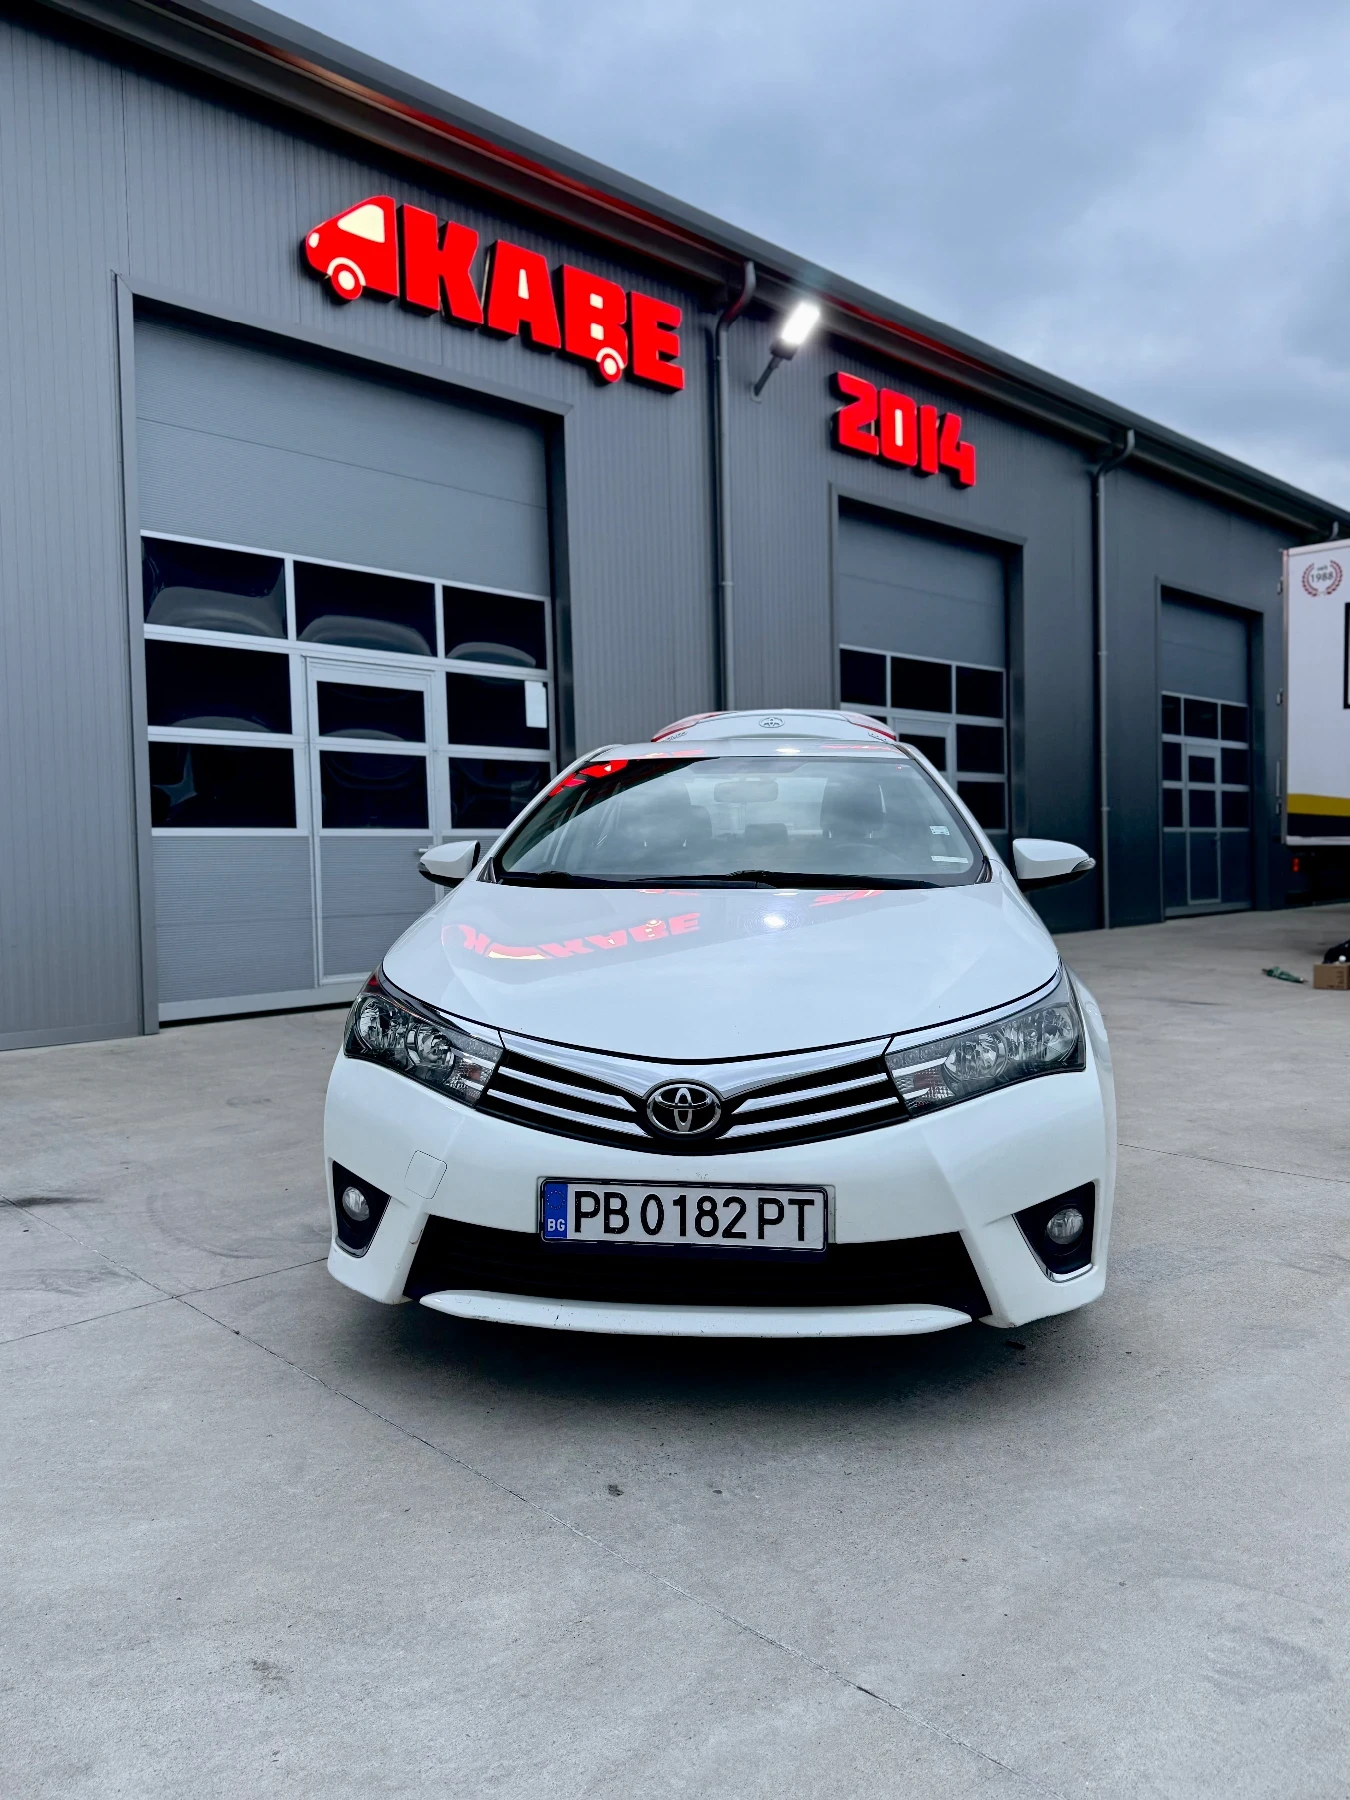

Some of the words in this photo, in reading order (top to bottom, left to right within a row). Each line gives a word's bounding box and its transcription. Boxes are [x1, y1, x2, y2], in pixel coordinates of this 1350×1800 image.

[836, 371, 977, 487] 2014
[1311, 571, 1334, 583] 1988
[547, 1218, 566, 1231] BG
